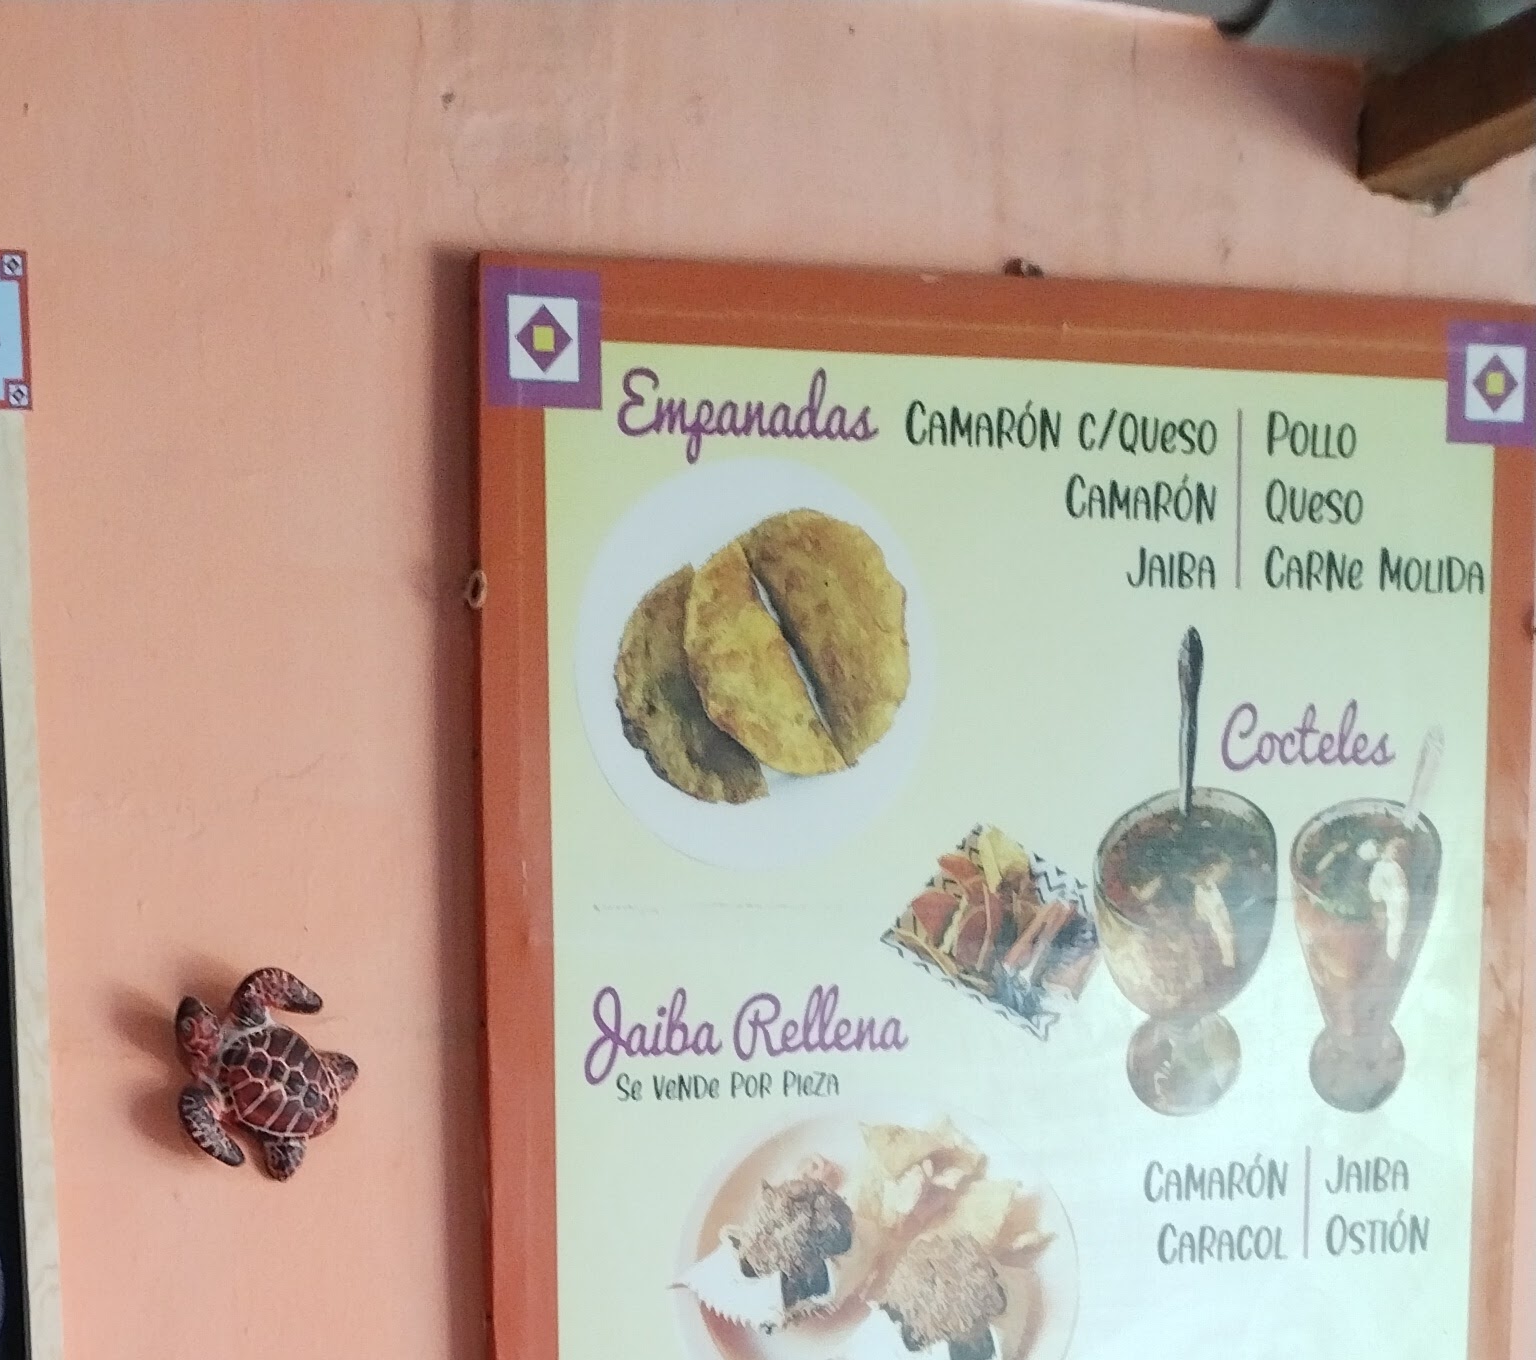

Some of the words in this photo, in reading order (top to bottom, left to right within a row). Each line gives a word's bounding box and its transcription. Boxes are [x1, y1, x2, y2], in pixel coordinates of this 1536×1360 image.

[617, 367, 879, 464] Empanadas
[905, 399, 1061, 451] CAMARÓN
[1267, 410, 1357, 460] POLLO
[1065, 473, 1217, 525] CAMARÓN
[1125, 547, 1217, 591] JAIBA
[1379, 547, 1485, 595] MOLIDA
[1220, 699, 1396, 772] Cocteles
[584, 986, 723, 1085] Jaiba
[733, 984, 909, 1061] Rellena
[731, 1071, 772, 1099] POR
[1143, 1152, 1289, 1203] CAMARÓN
[1325, 1154, 1410, 1194] JAIBA
[1157, 1222, 1289, 1265] CARACOL
[1325, 1208, 1431, 1256] OSTIÓN
